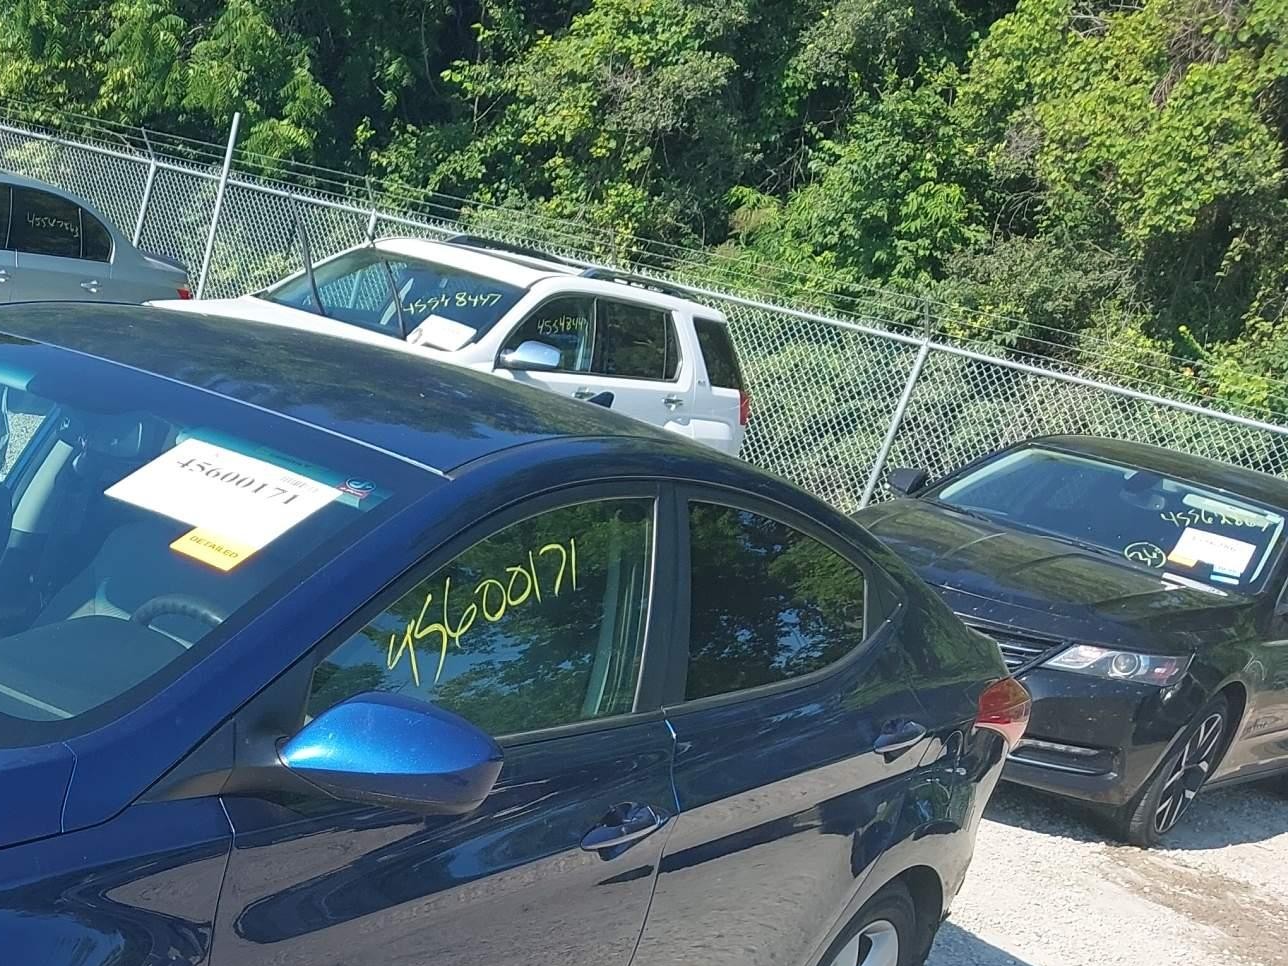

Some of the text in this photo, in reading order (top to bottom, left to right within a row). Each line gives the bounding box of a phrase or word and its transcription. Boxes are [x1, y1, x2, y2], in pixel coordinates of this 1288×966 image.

[403, 292, 502, 315] 45548447
[176, 457, 301, 505] 45600171
[188, 535, 239, 559] DETAILED
[387, 538, 577, 687] 45600171
